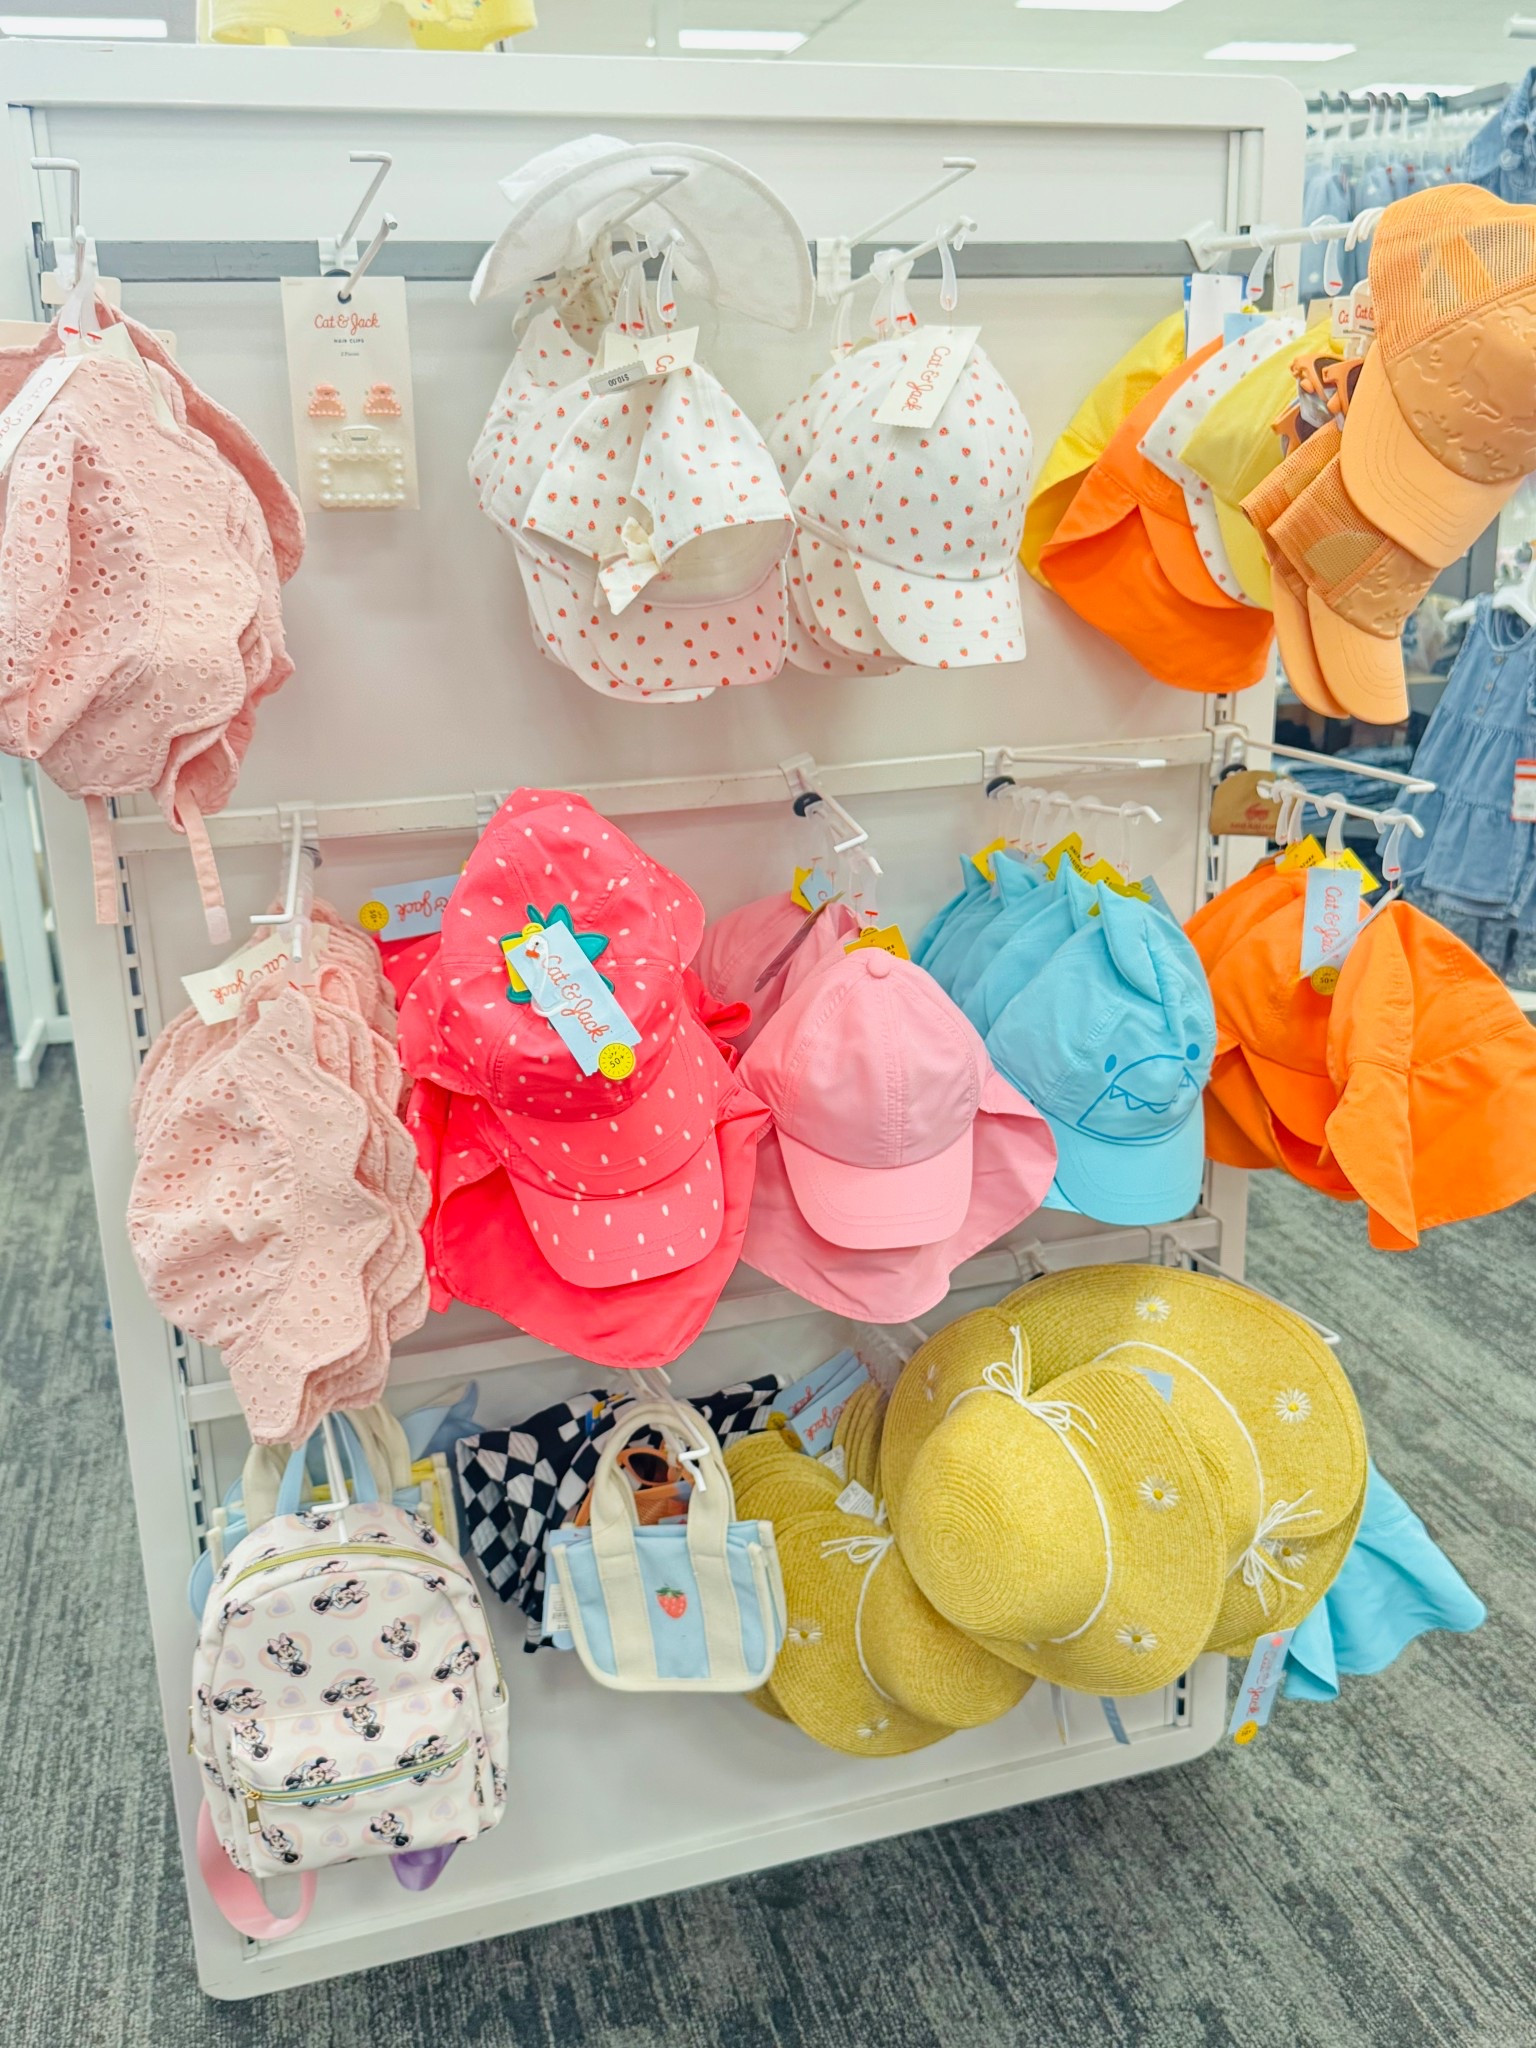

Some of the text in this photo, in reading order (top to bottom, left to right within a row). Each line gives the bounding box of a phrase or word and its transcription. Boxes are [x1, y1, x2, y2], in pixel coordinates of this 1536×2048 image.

[314, 312, 380, 336] Cat & Jack
[655, 354, 675, 374] Ca
[607, 373, 631, 387] $10.00
[901, 345, 951, 412] Cat & Jack
[394, 890, 433, 922] Jack
[1324, 886, 1343, 911] Cat
[541, 954, 611, 1044] Cat & Jack
[609, 1054, 625, 1069] 50+
[803, 1406, 833, 1441] Jack
